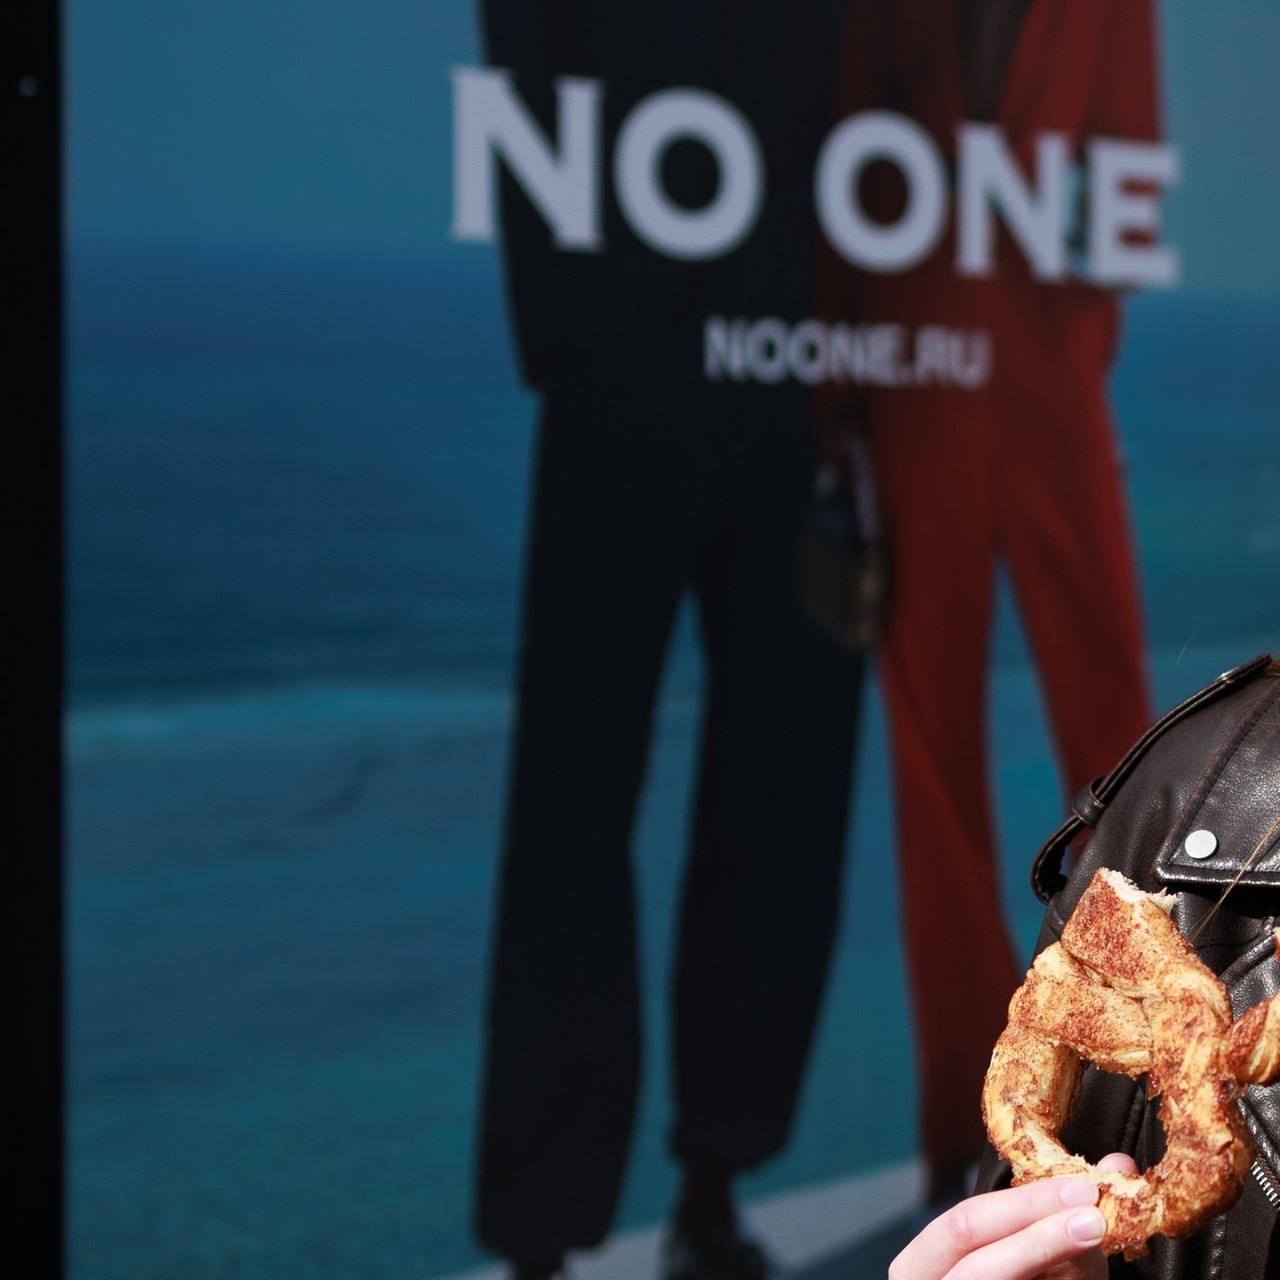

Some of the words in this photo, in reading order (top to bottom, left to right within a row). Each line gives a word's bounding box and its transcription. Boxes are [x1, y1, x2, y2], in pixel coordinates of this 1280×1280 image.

[450, 65, 765, 262] NO
[814, 109, 1182, 289] ONE
[704, 316, 991, 389] NOONE.RU
